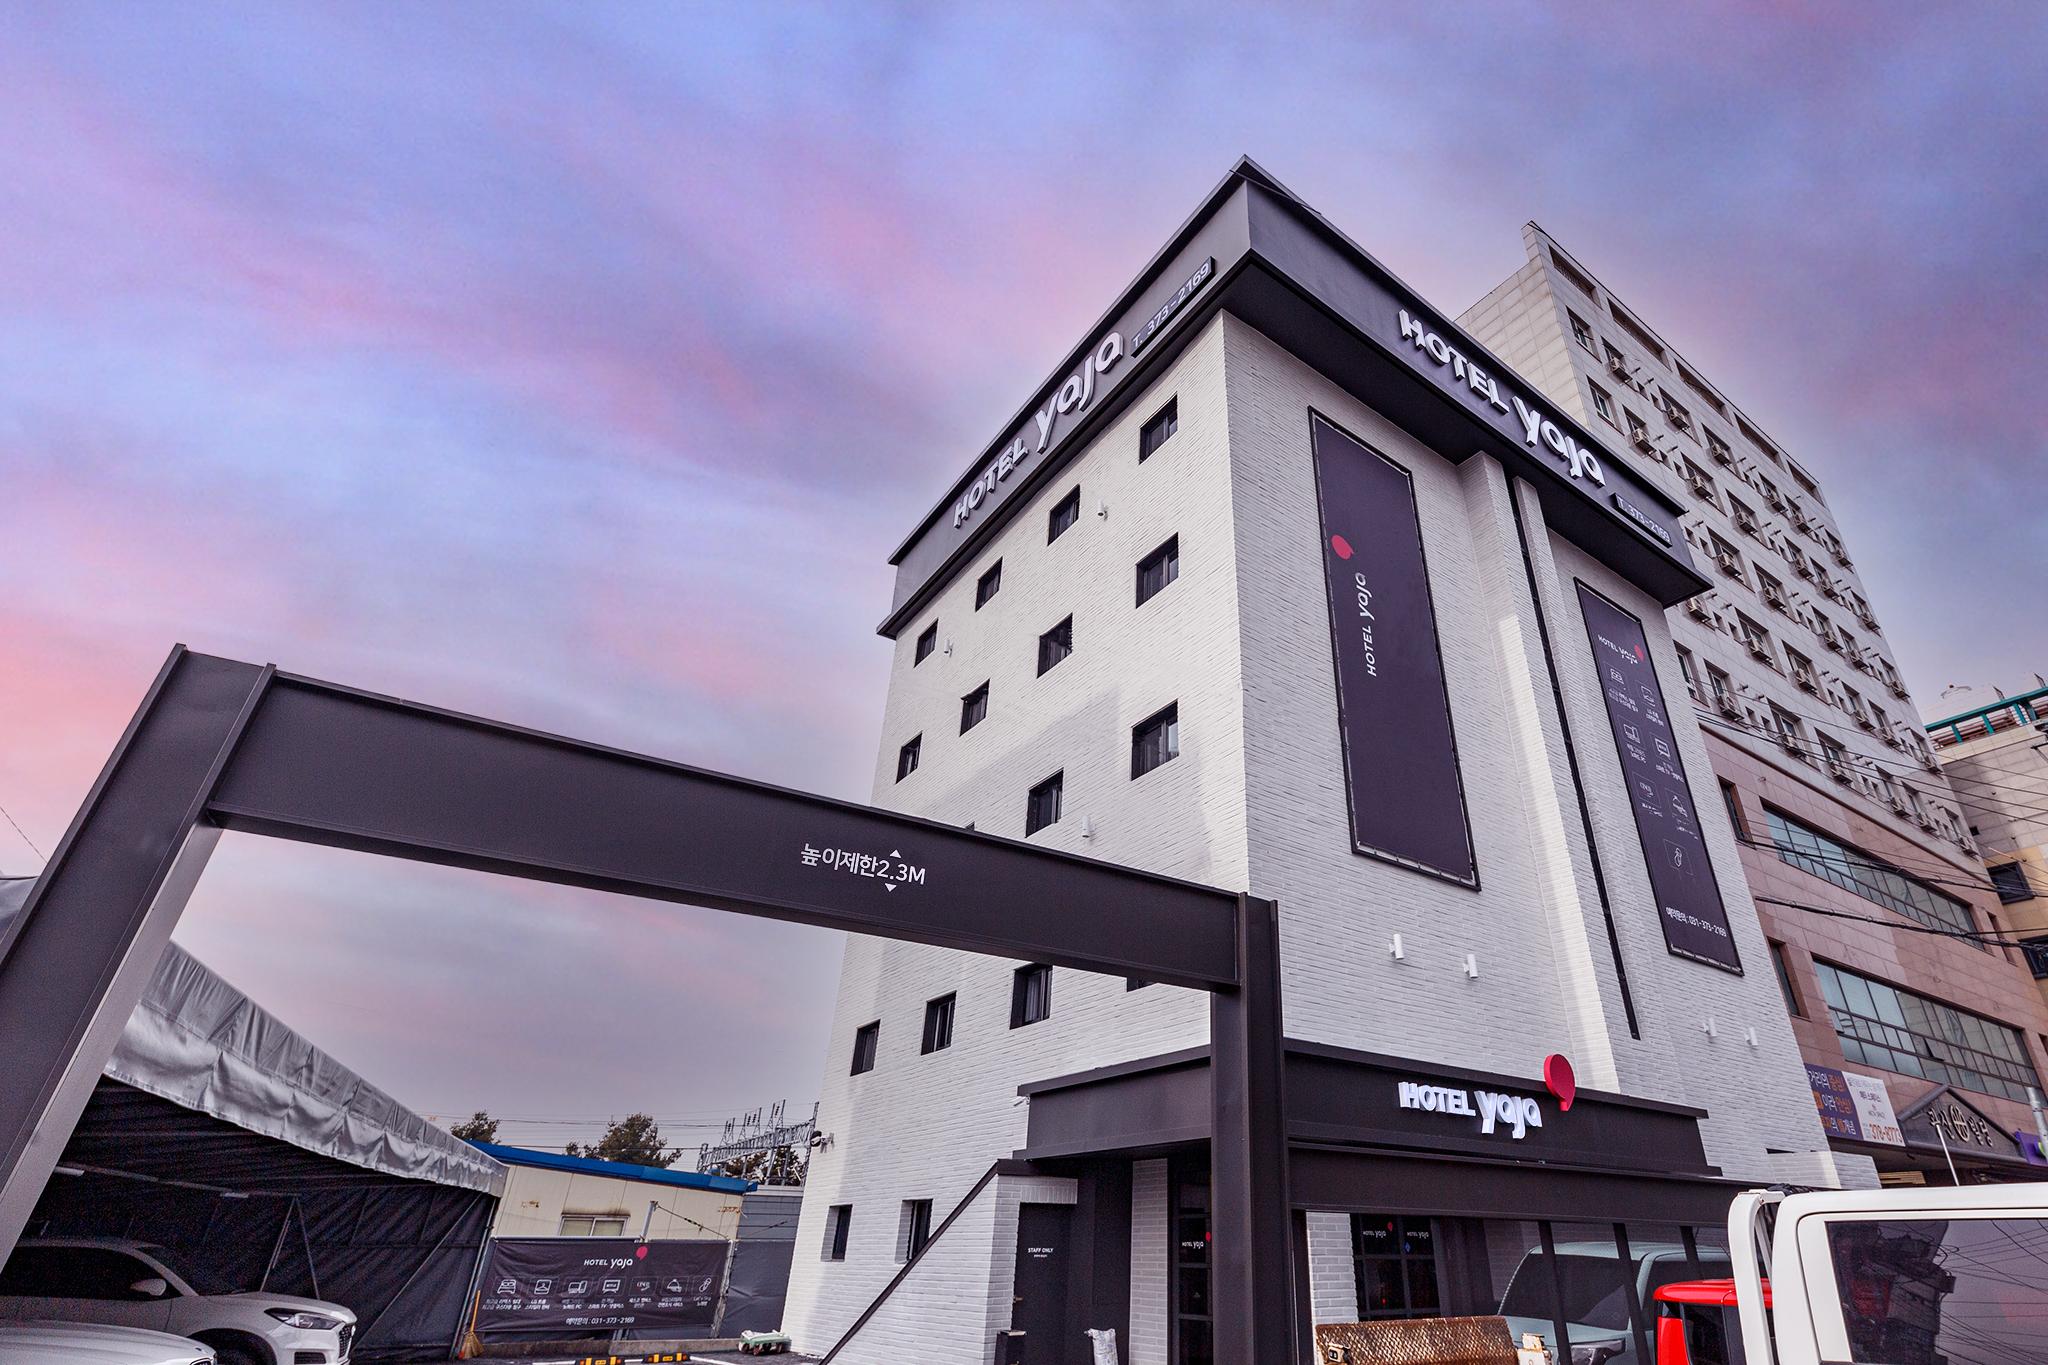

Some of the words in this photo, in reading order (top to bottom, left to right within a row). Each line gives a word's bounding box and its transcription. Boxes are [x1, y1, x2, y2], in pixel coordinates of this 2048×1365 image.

[1398, 308, 1510, 415] HOTEL
[953, 437, 1030, 528] HOTEL
[1361, 625, 1377, 677] HOTEL
[1597, 634, 1619, 654] HOTEL
[1398, 1081, 1476, 1117] HOTEL
[583, 1259, 609, 1268] HOTEL
